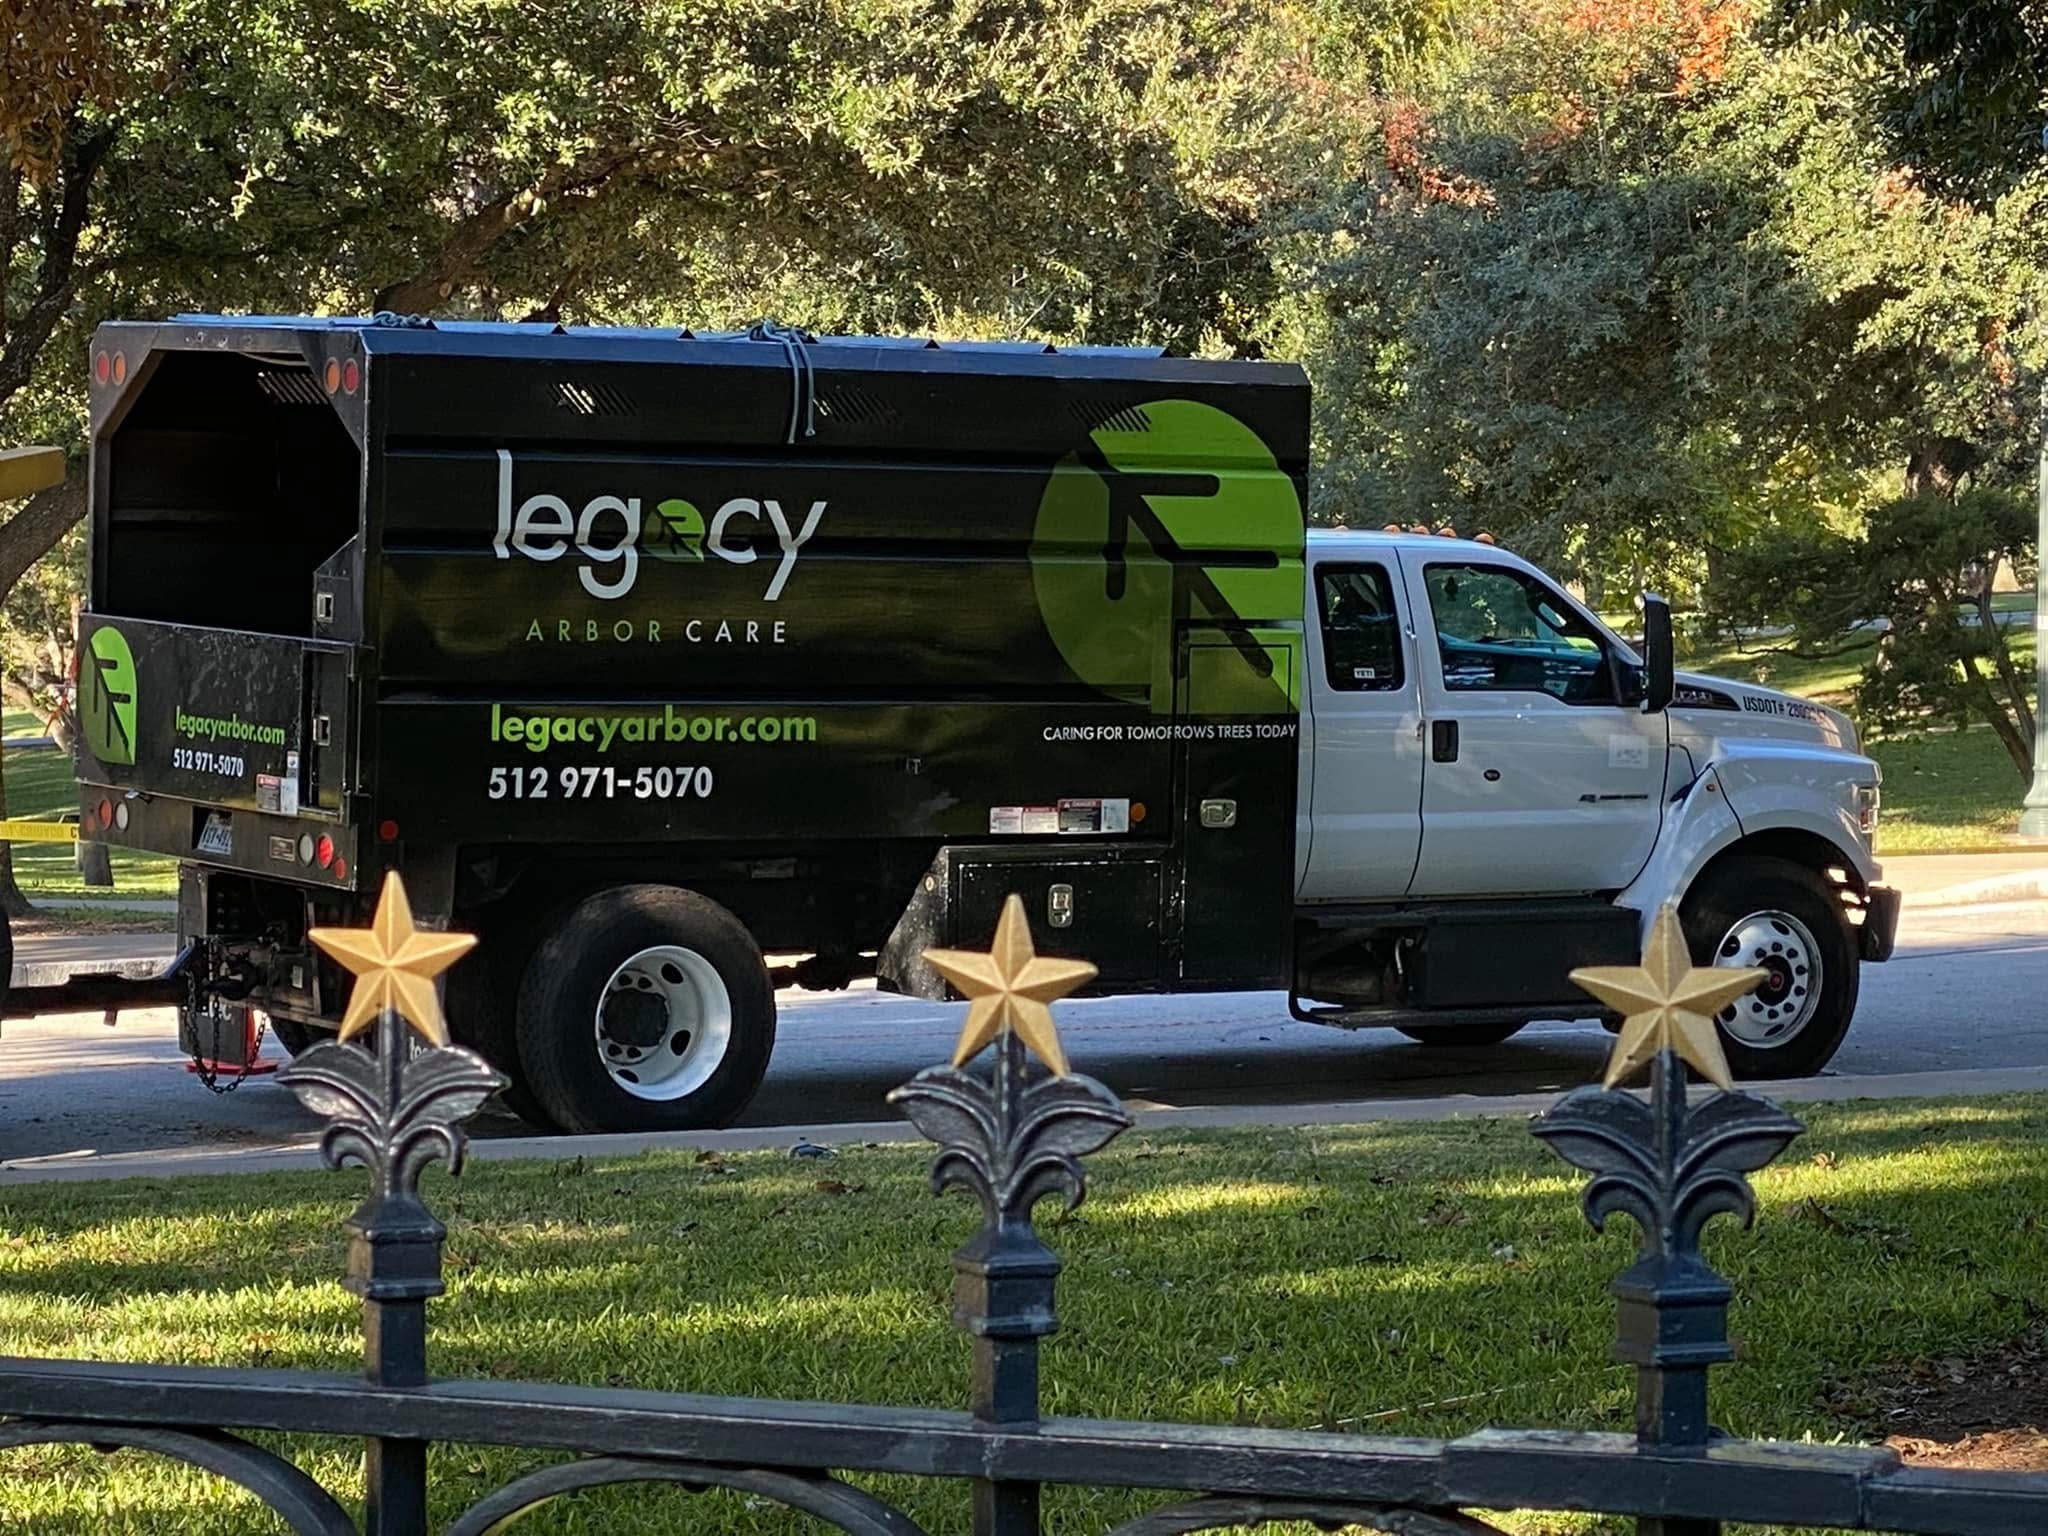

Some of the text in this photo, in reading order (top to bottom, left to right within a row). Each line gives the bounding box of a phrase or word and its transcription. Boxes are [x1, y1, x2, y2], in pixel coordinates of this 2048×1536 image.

[493, 449, 828, 601] legacy
[526, 618, 786, 643] ARBOR CARE
[1742, 696, 1785, 716] USDOT#
[176, 706, 285, 745] legacyarbor.com
[491, 703, 817, 752] legacyarbor.com
[1043, 726, 1095, 741] CARING
[1096, 726, 1123, 740] FOR
[1218, 725, 1253, 739] TREES
[1255, 724, 1296, 738] TODAY
[173, 749, 243, 777] 512 971-5070
[488, 766, 713, 799] 512 971-5070
